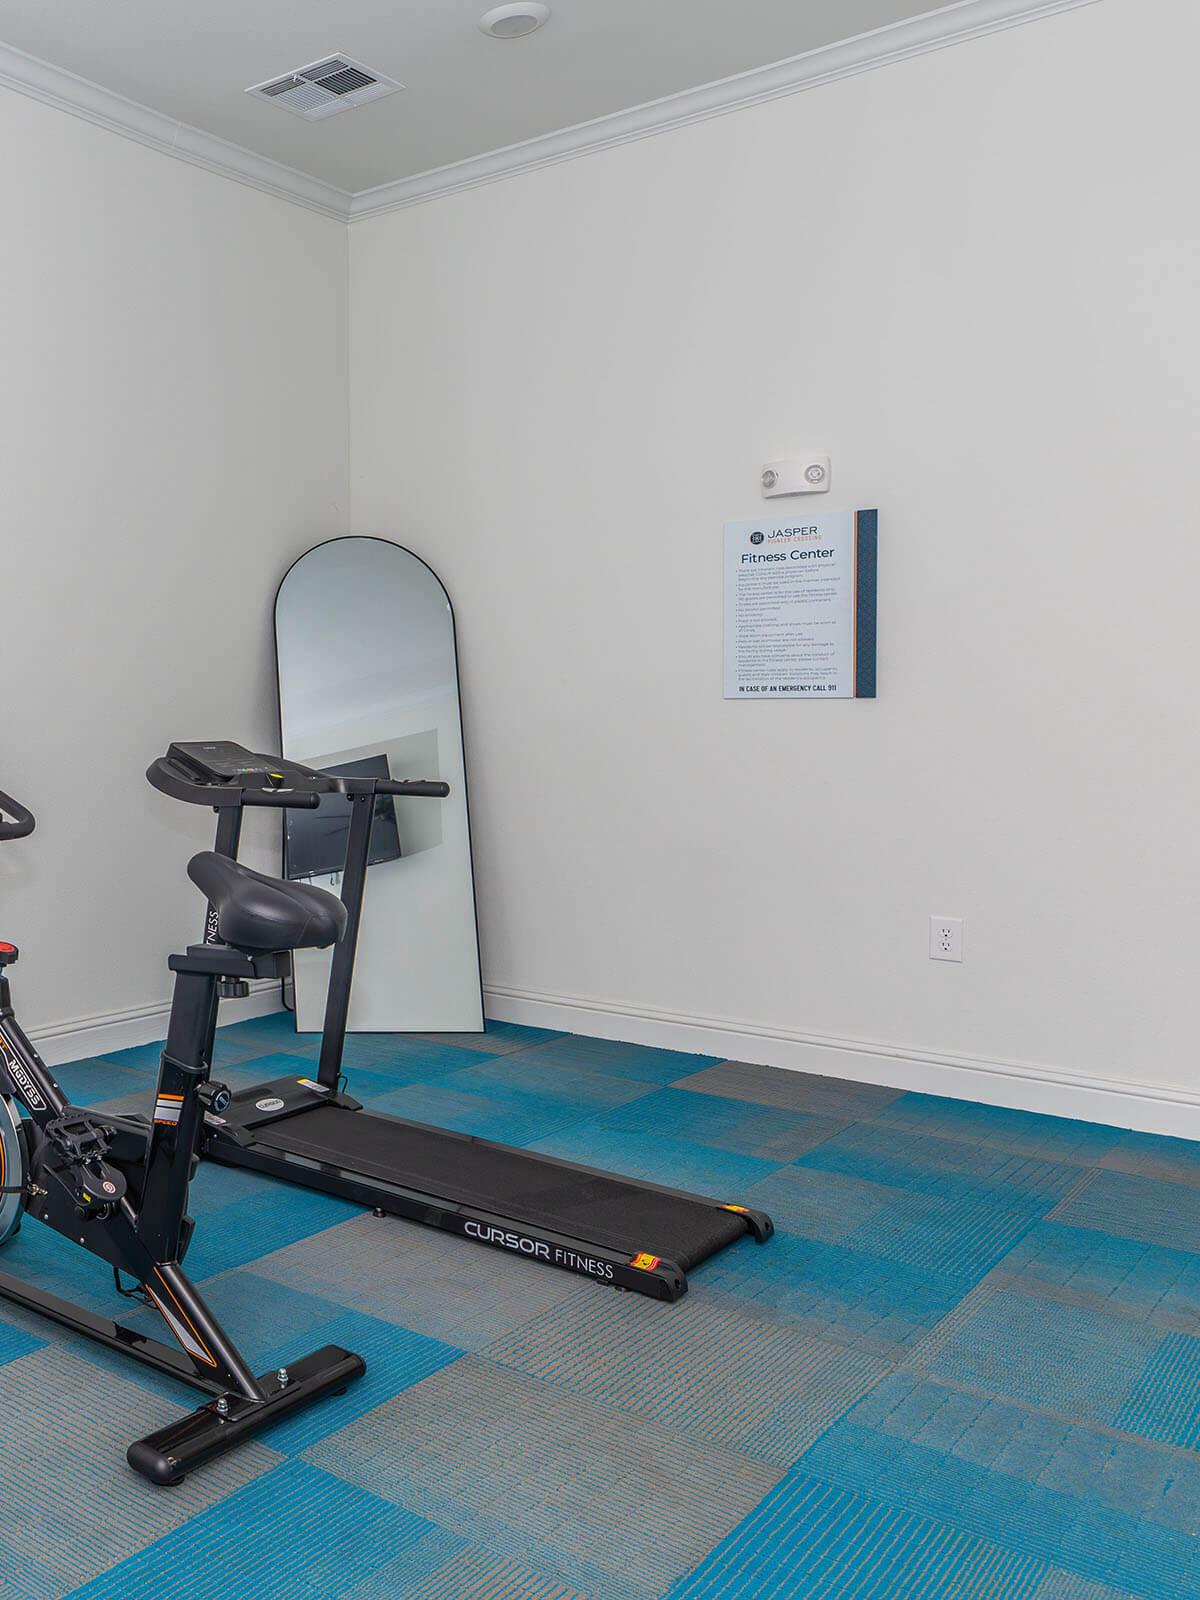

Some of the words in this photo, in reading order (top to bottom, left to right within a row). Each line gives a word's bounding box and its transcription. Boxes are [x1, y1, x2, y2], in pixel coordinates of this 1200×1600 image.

[767, 526, 818, 539] JASPER
[741, 550, 787, 564] Fitness
[790, 547, 835, 561] Center
[8, 1058, 42, 1105] MGDYSS
[464, 1221, 550, 1260] CURSOR
[555, 1249, 614, 1279] FITNESS
